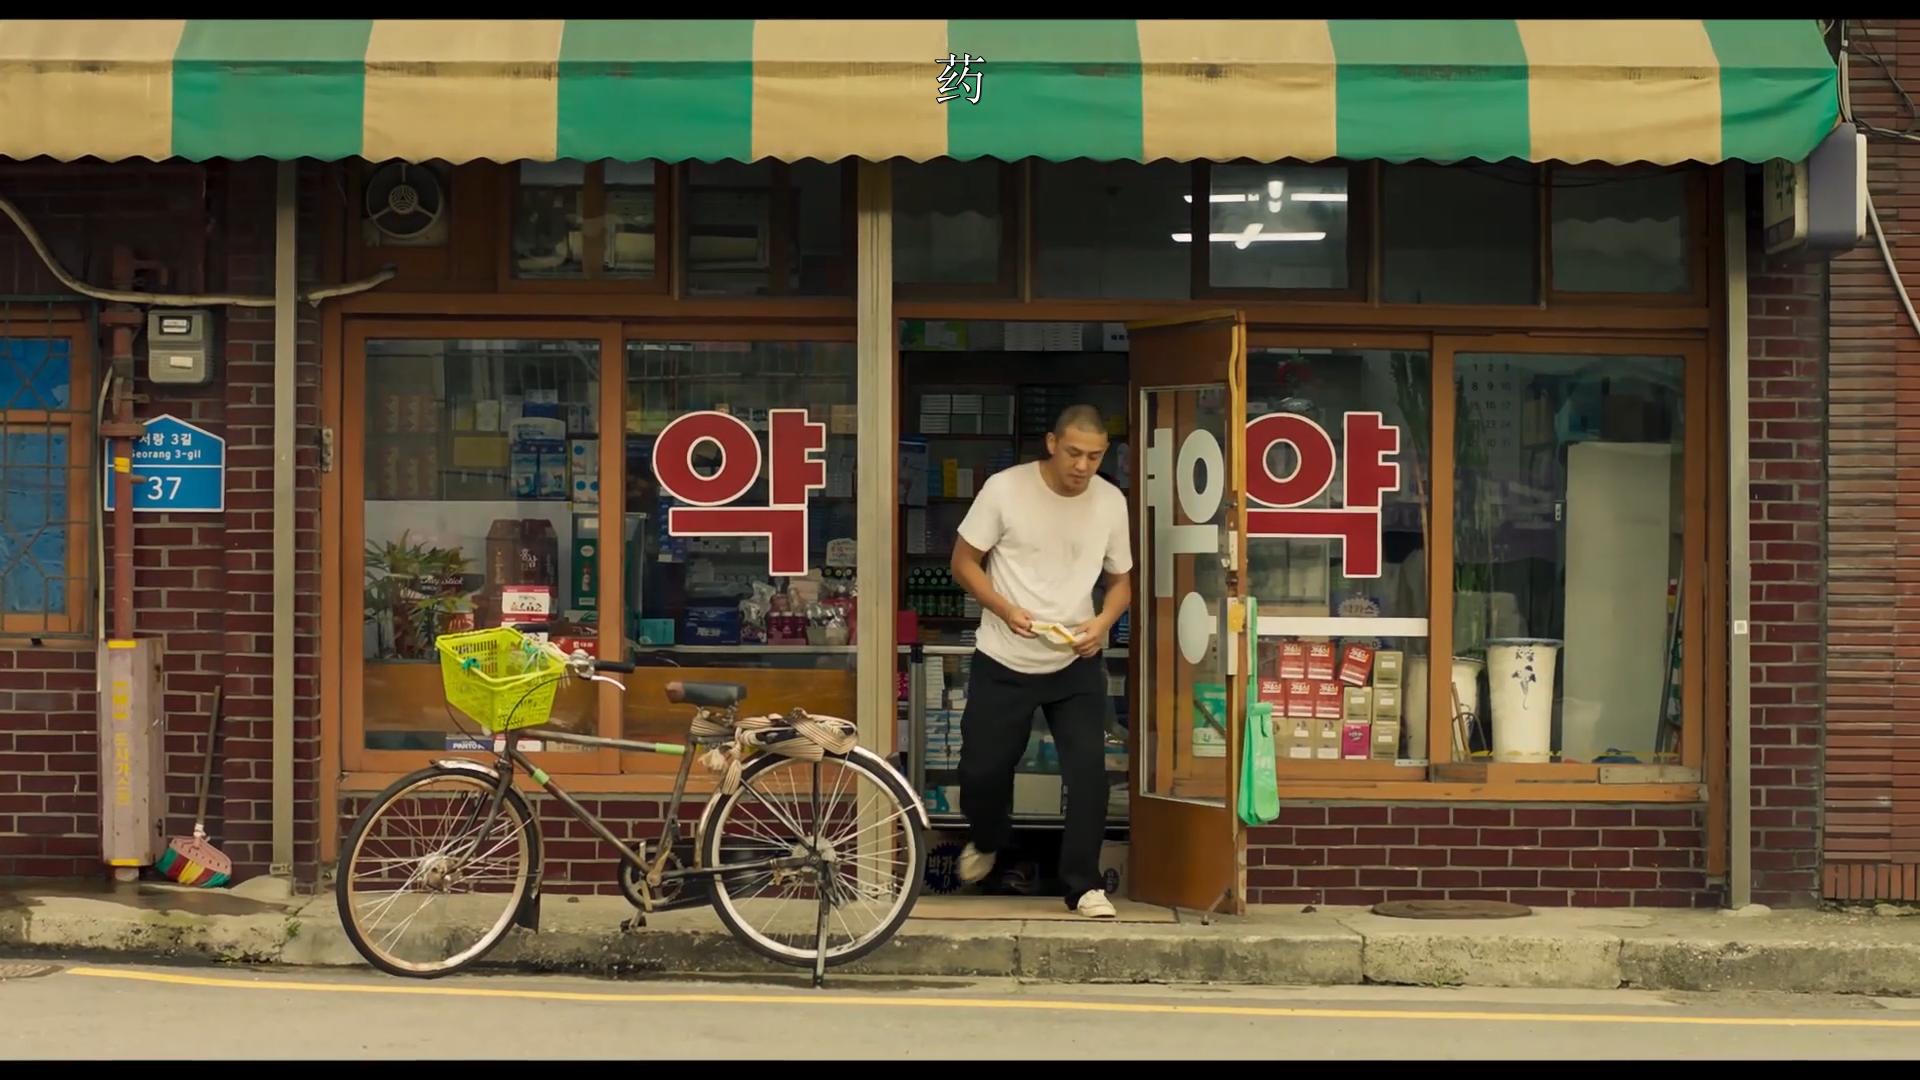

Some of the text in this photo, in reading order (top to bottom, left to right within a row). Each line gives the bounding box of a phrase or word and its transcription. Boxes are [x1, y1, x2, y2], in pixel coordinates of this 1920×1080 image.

[1471, 382, 1479, 391] 8
[1487, 382, 1494, 391] 9
[139, 432, 192, 446] 서랑 3길
[174, 449, 201, 460] 3-gil
[147, 475, 182, 500] 37
[652, 408, 826, 577] 약
[1246, 411, 1400, 578] 약
